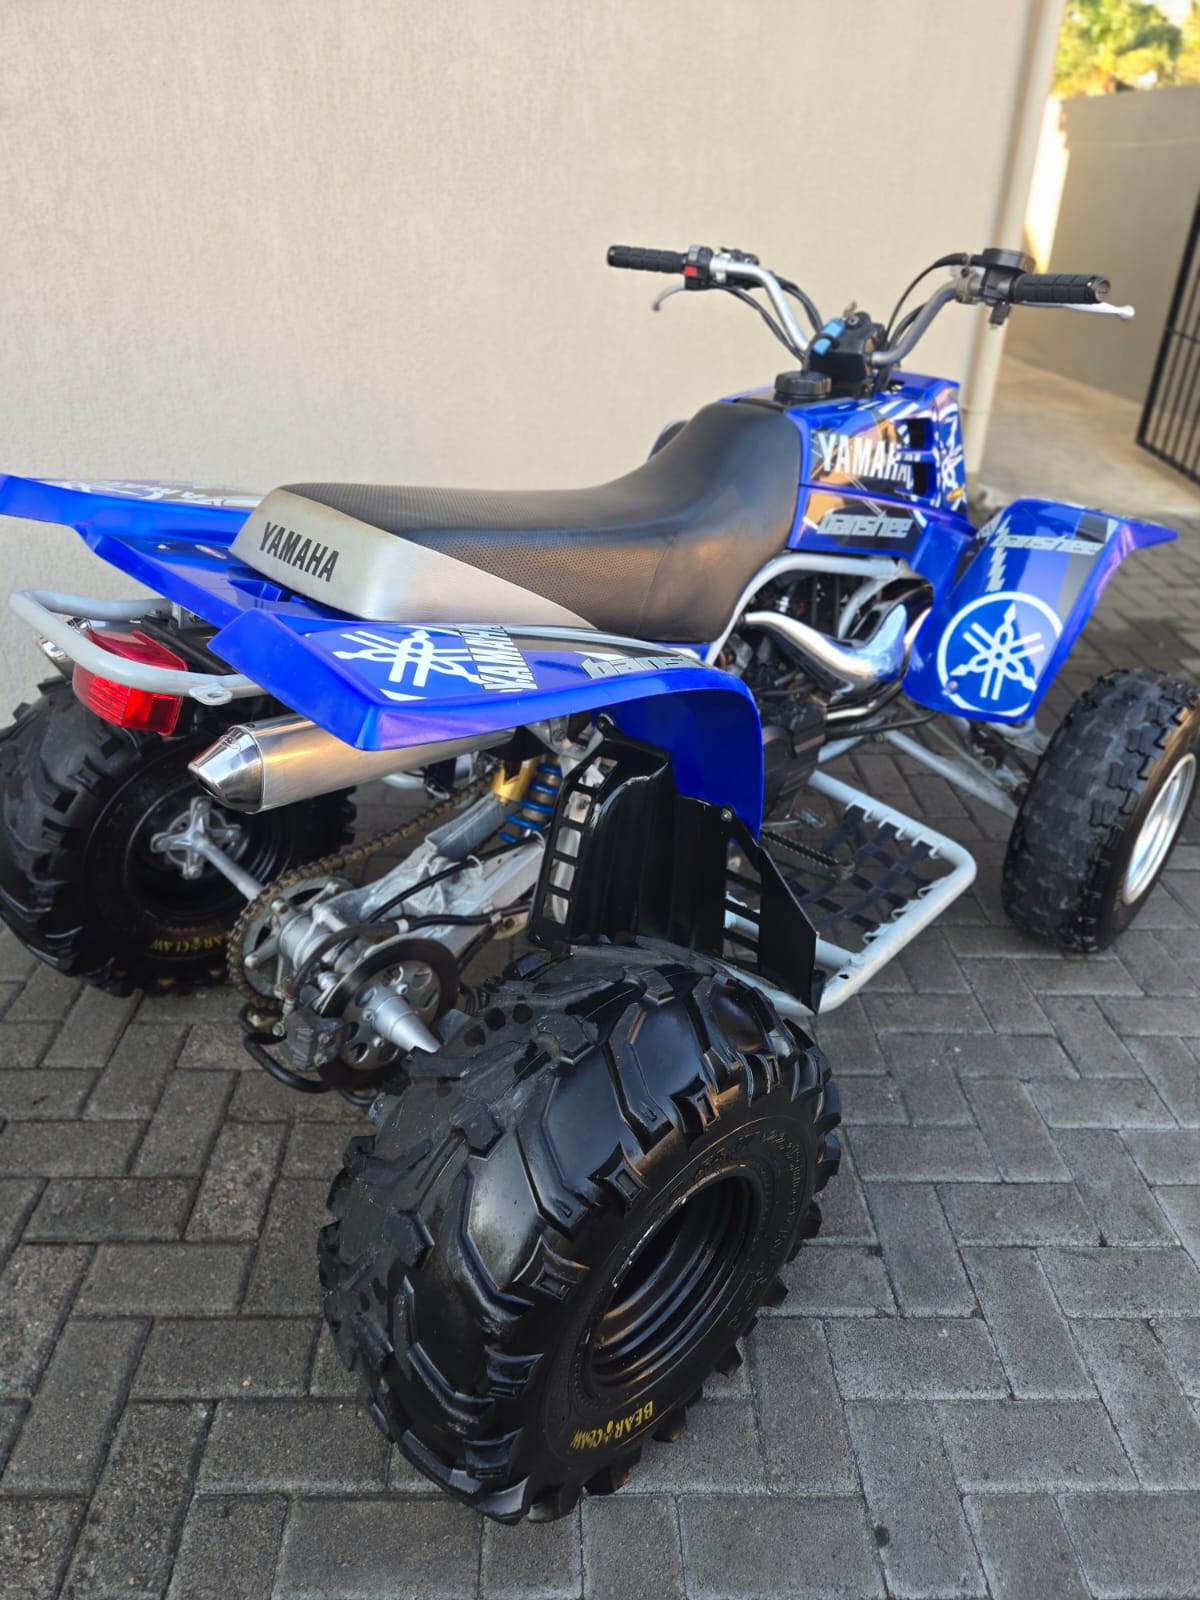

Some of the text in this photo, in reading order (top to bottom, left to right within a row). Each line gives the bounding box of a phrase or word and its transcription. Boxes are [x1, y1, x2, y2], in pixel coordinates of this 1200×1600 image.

[260, 521, 339, 582] YAMAHA
[150, 939, 190, 952] CLAW
[614, 1400, 654, 1439] BEAR
